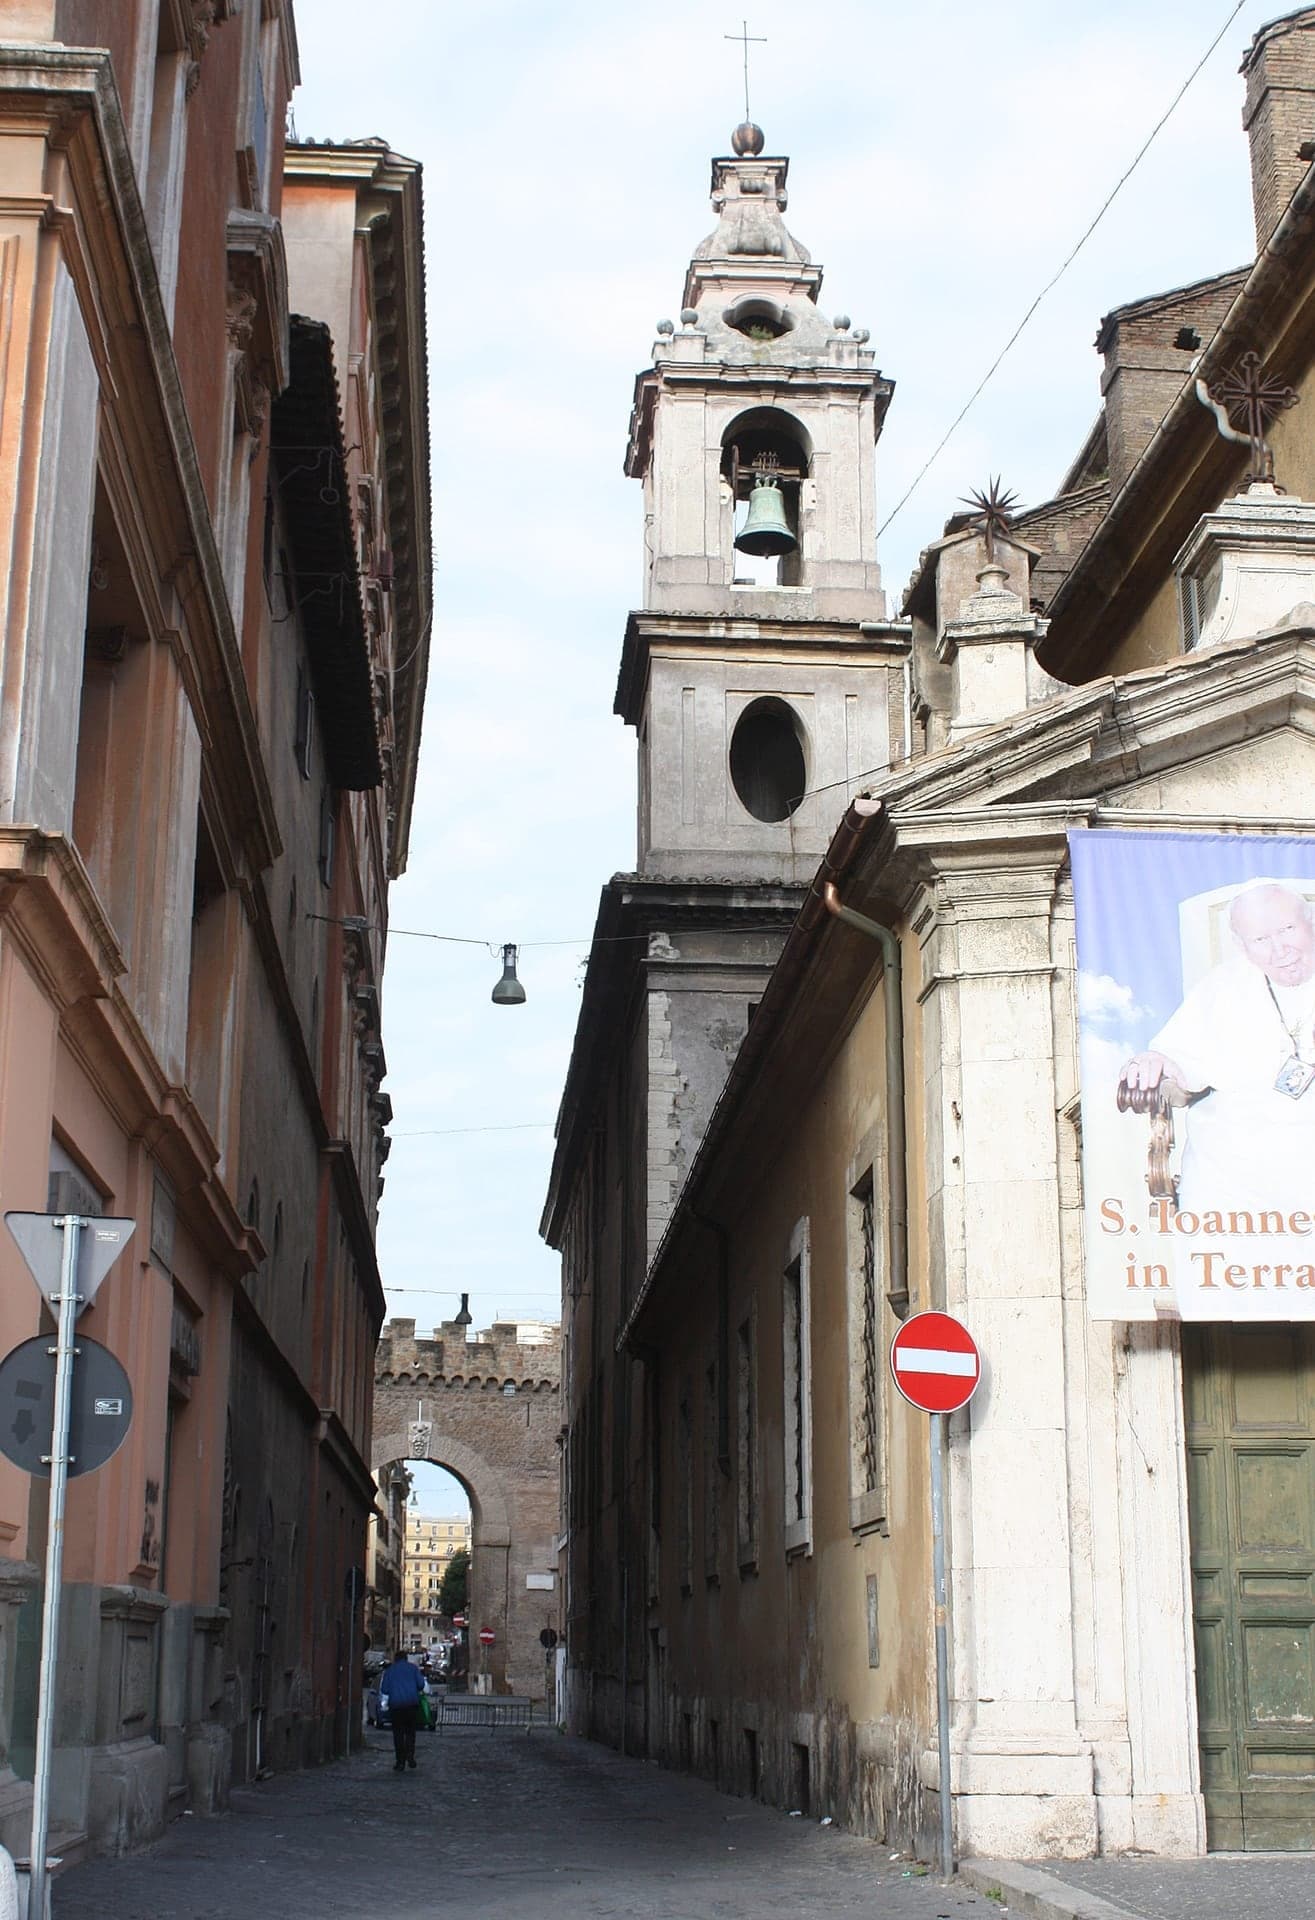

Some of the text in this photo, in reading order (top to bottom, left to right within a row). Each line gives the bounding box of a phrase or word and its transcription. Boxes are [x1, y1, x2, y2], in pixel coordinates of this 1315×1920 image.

[1100, 1198, 1315, 1235] S. Ioanne
[1126, 1252, 1170, 1288] in
